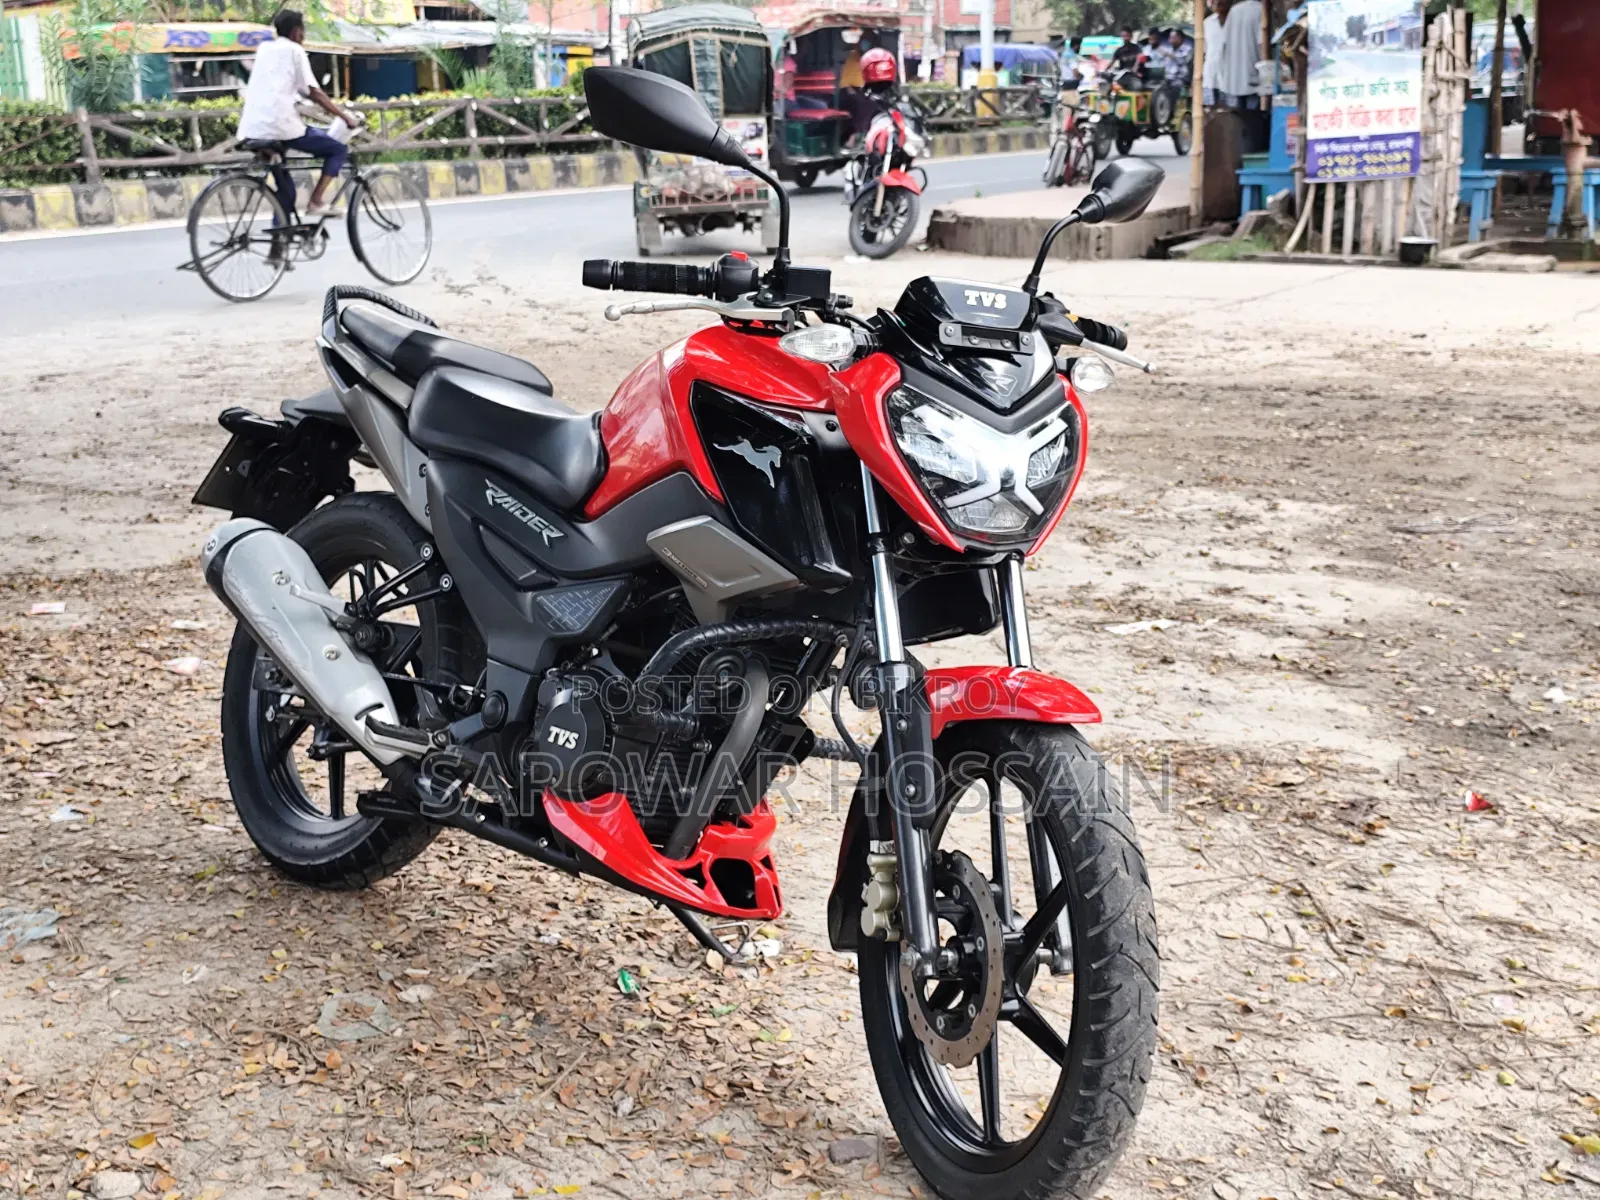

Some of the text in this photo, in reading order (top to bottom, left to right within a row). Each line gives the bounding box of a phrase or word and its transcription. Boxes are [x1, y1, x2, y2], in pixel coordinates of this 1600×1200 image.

[964, 289, 1007, 309] TVS
[485, 478, 568, 548] RAIDER
[548, 725, 580, 750] TVS
